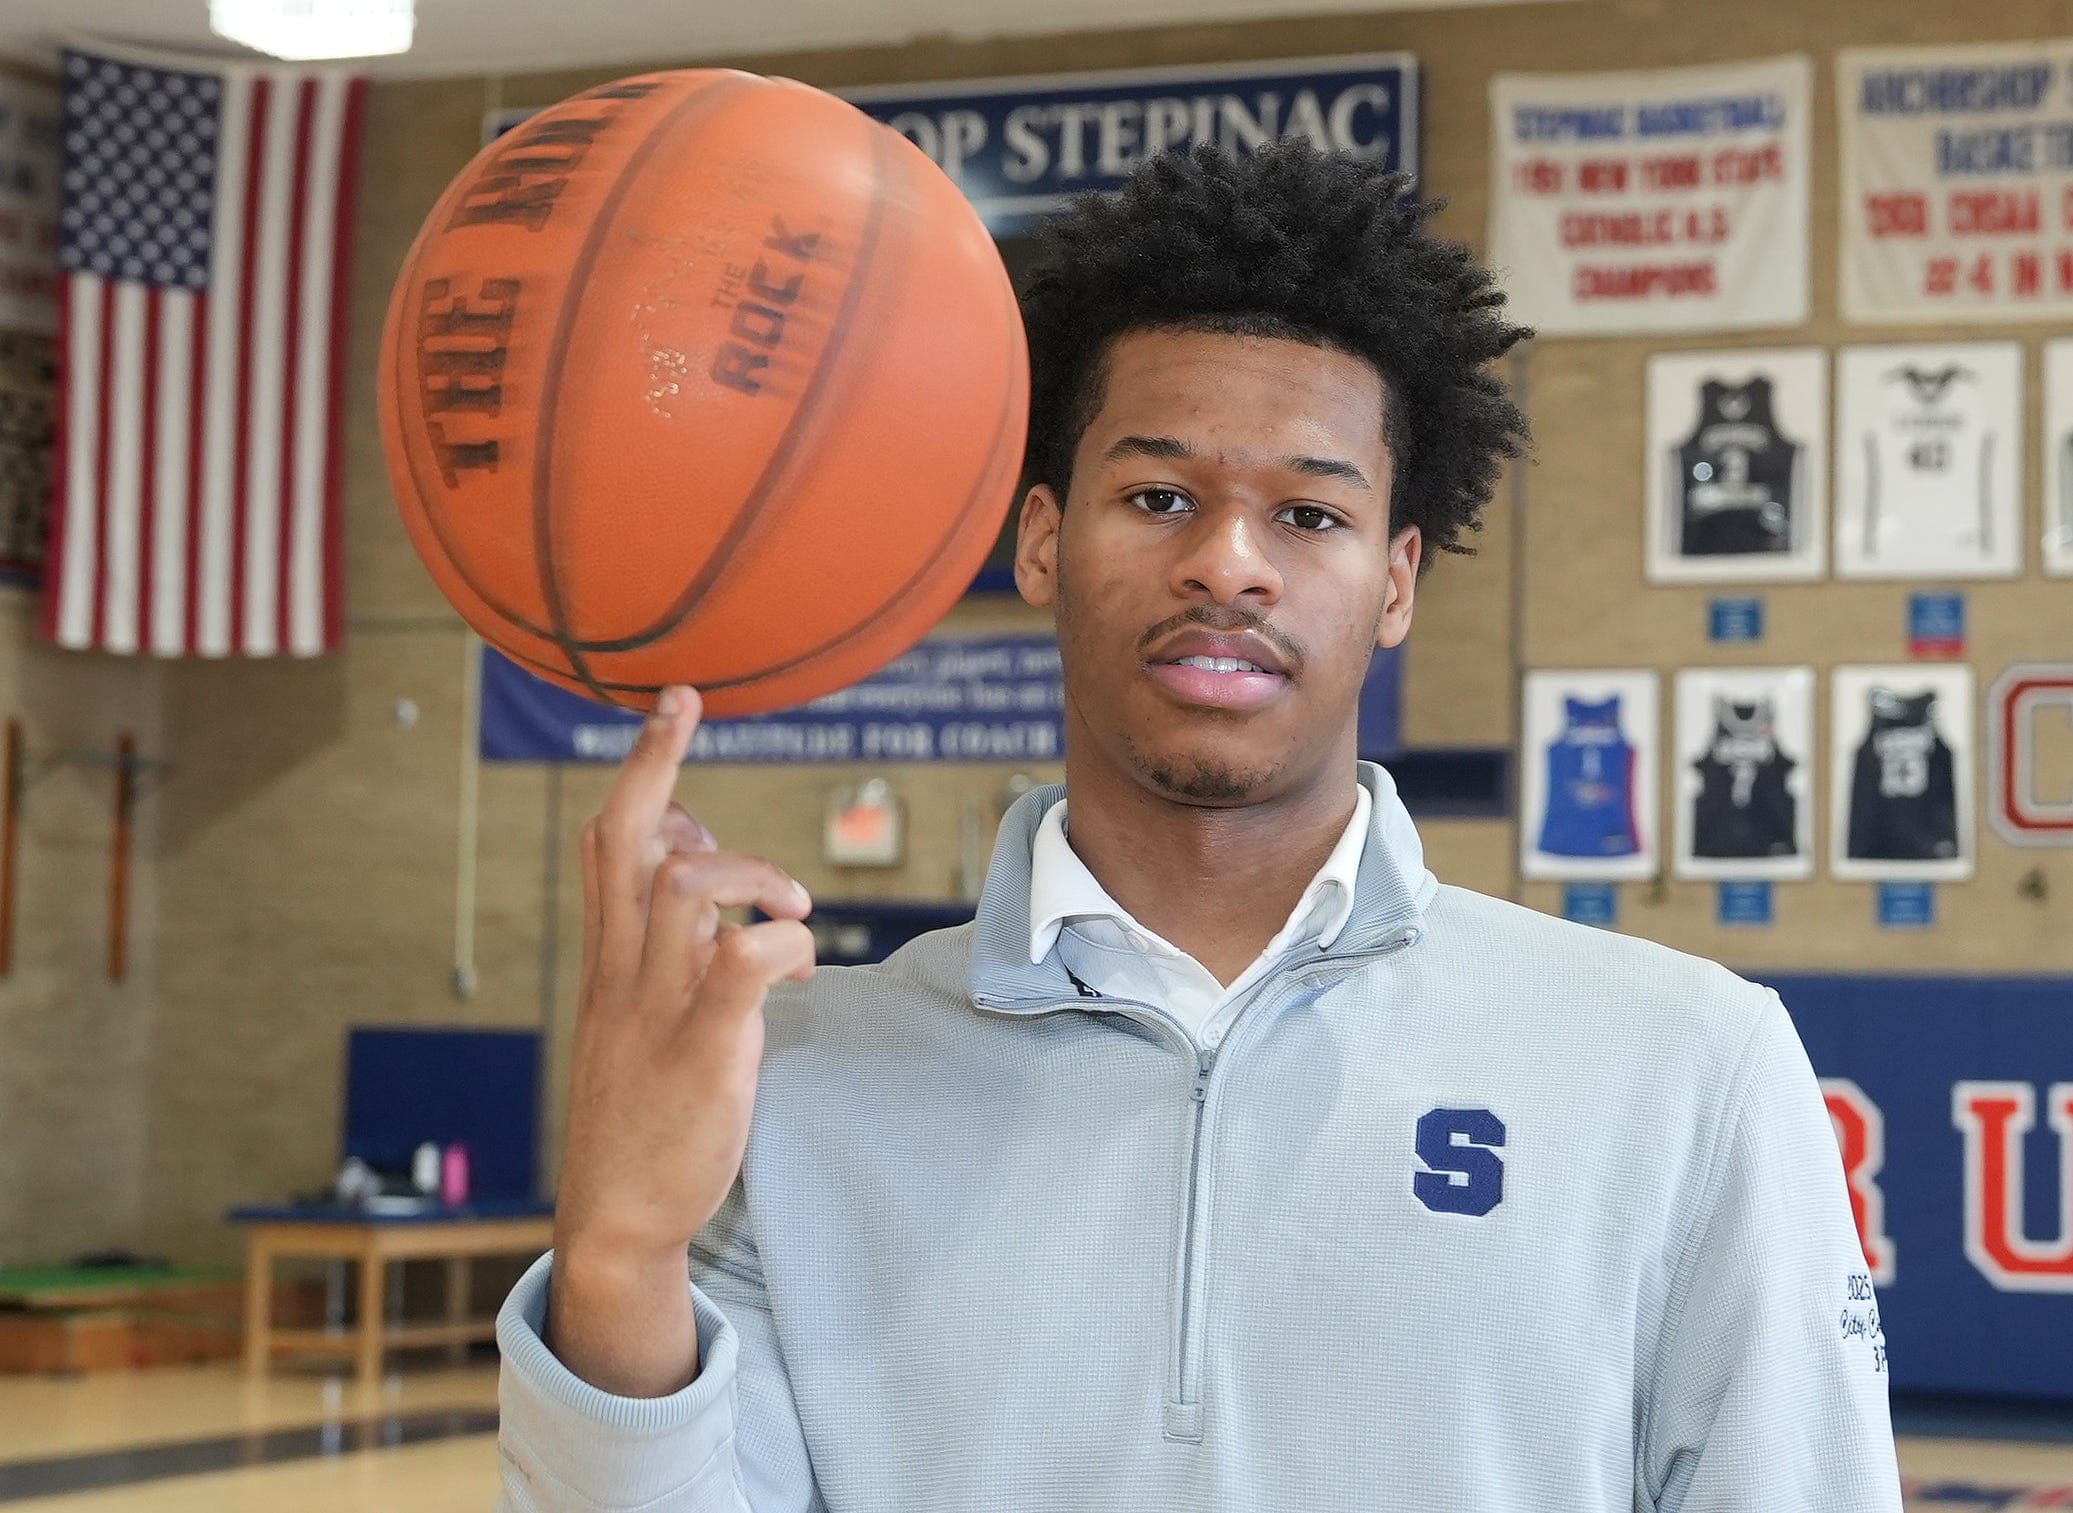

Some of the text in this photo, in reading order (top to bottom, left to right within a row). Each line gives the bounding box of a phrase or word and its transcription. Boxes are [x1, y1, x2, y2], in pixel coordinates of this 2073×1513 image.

[416, 277, 523, 490] THE
[710, 213, 821, 397] ROCK
[1413, 1107, 1506, 1217] S
